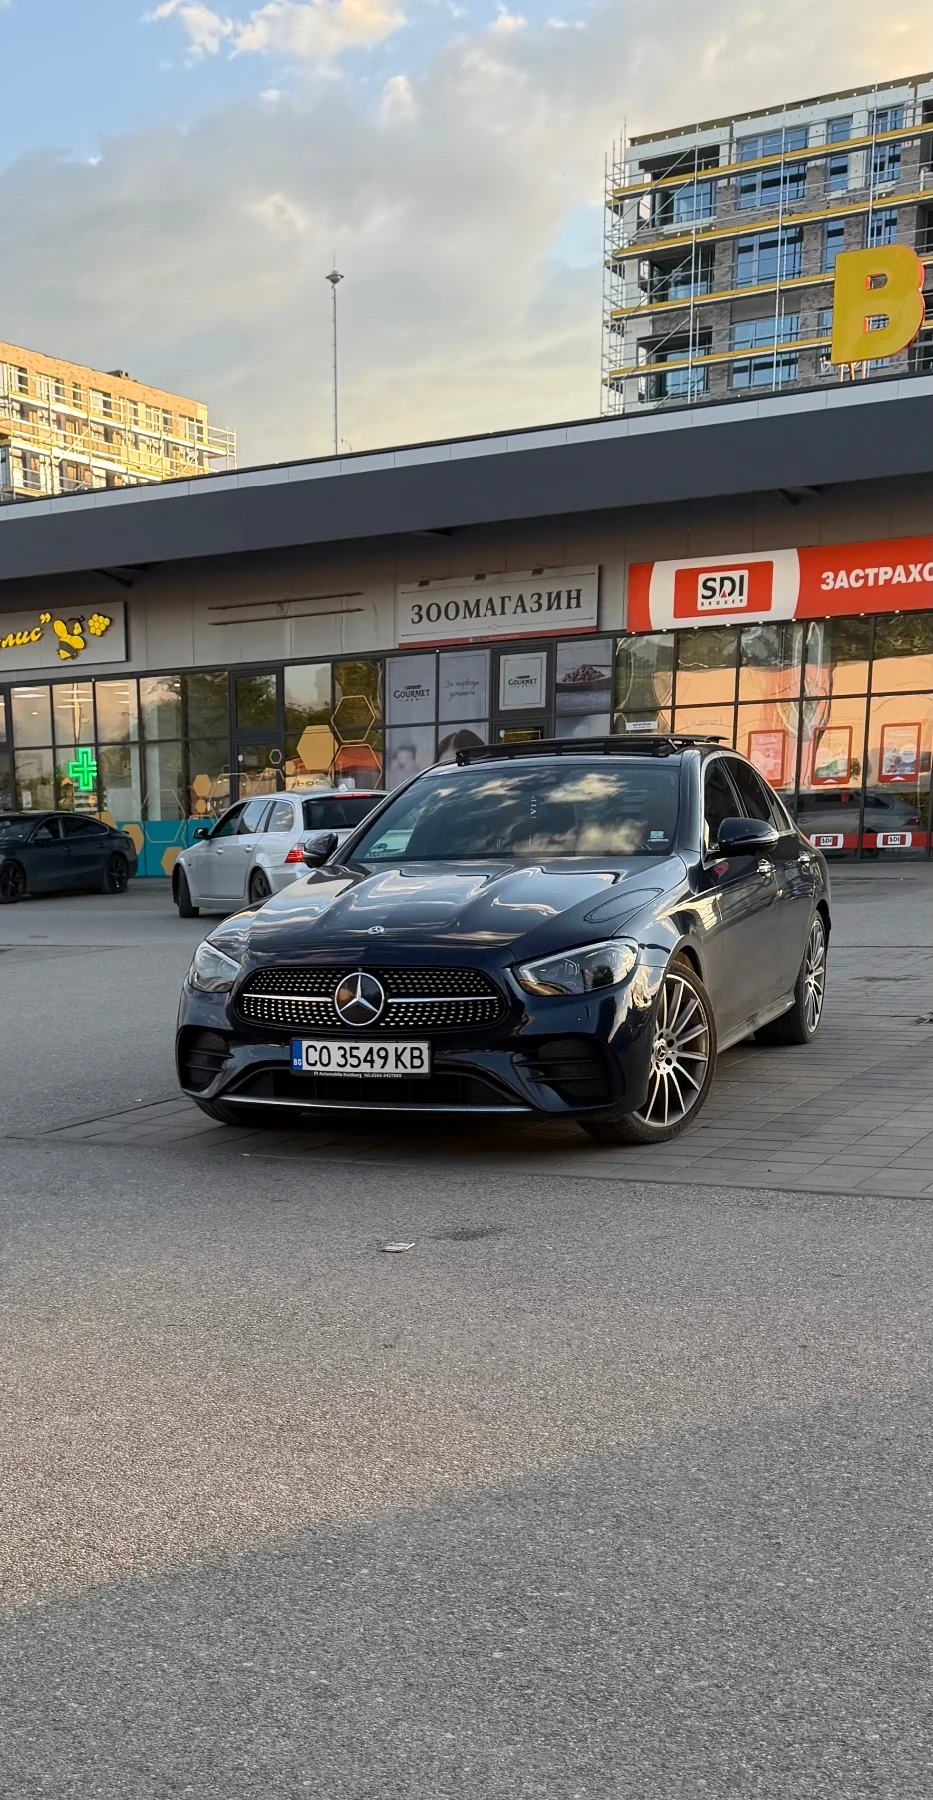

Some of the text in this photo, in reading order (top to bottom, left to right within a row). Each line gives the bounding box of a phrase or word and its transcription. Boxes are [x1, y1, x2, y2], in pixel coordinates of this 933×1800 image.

[701, 574, 745, 600] SDI
[820, 561, 933, 590] ЗАСТРАХО
[411, 589, 582, 624] ЗООМАГАЗИН
[393, 689, 431, 699] GOURMET
[305, 1045, 425, 1069] CO 3549 KB
